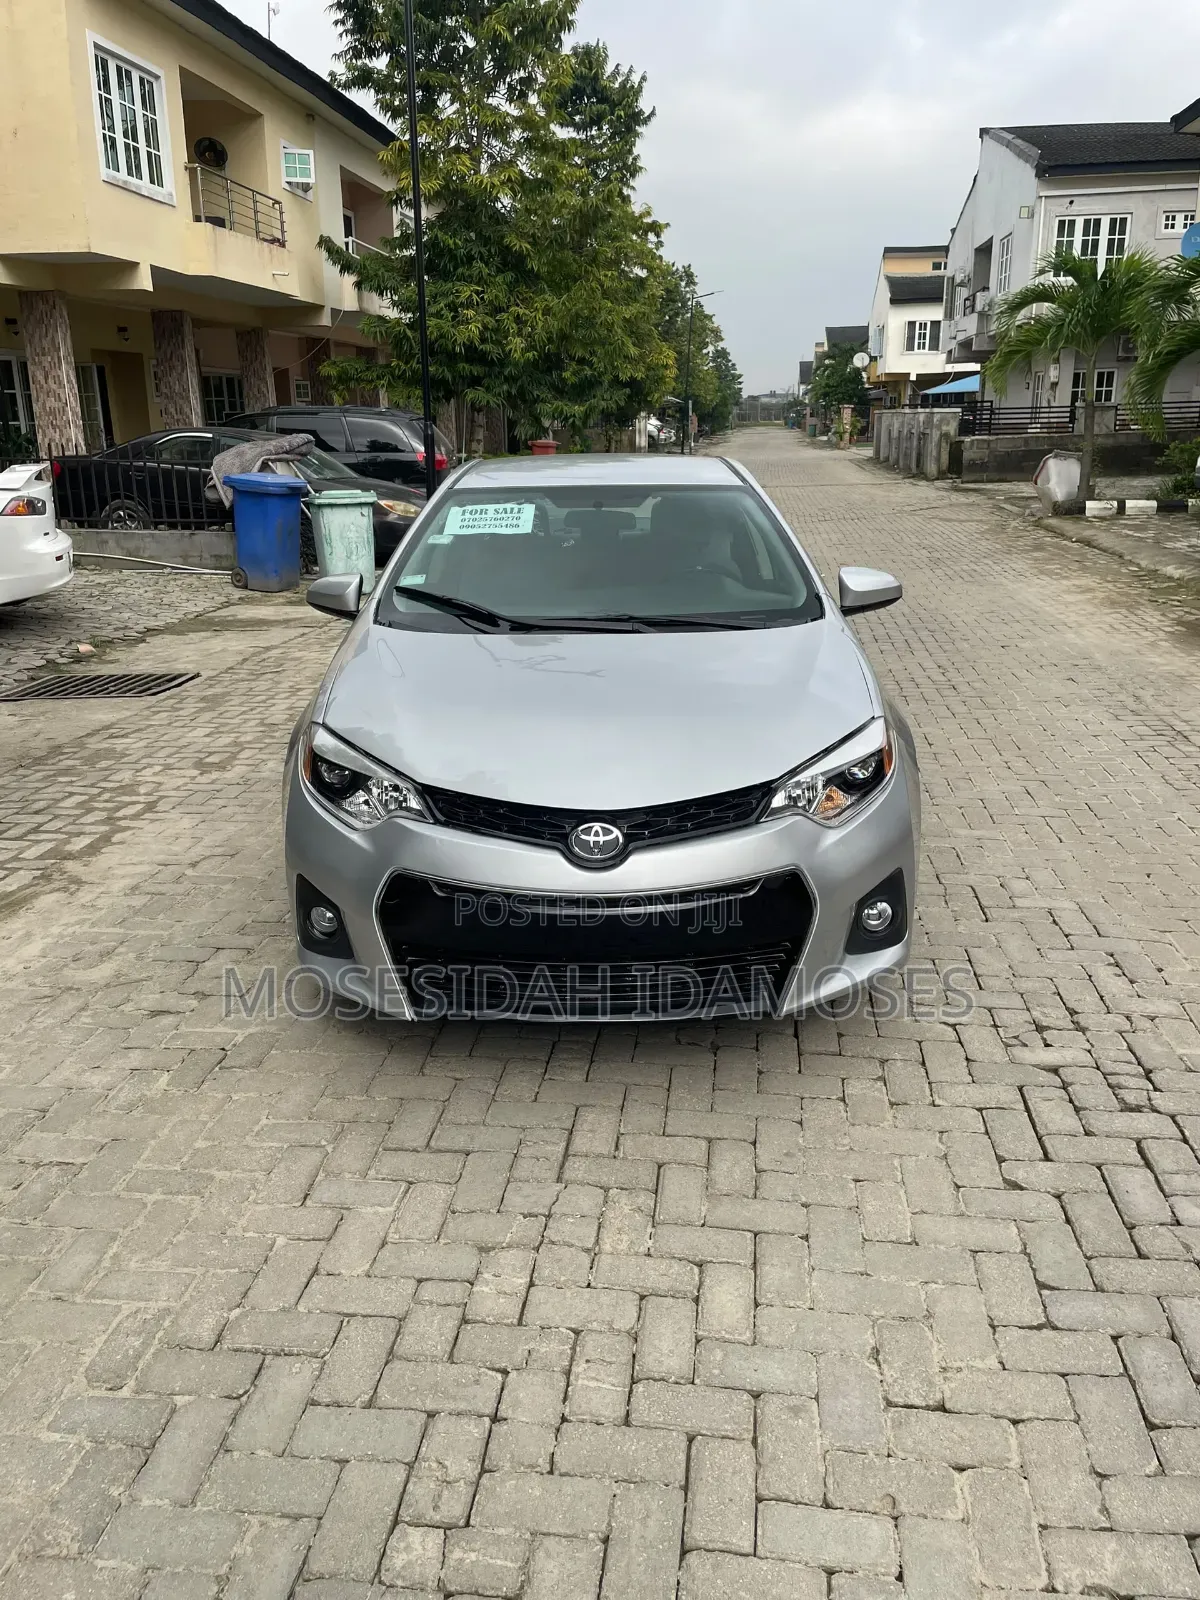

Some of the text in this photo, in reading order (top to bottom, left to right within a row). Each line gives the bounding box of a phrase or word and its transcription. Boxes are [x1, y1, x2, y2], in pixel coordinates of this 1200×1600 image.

[460, 507, 525, 516] FOR SALE
[460, 515, 521, 523] 07025760270
